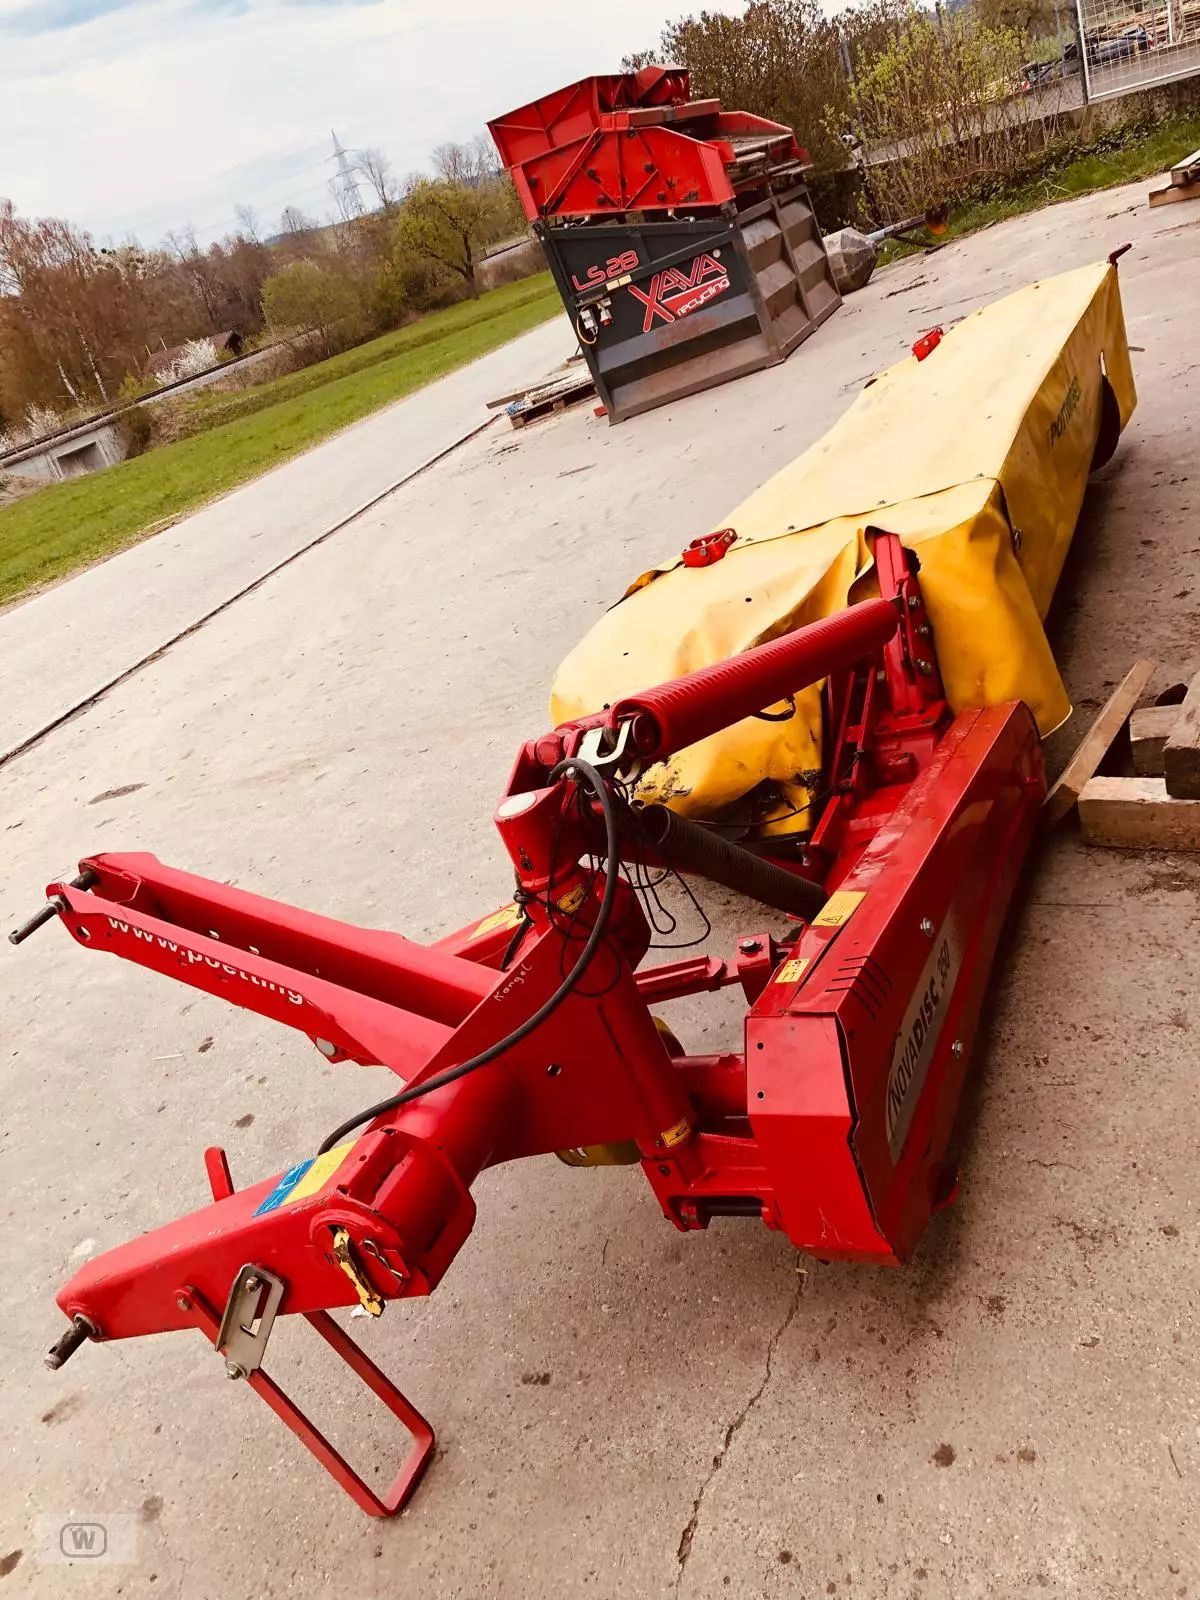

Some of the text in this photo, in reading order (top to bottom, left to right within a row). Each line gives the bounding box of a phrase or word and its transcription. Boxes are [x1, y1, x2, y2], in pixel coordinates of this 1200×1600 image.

[627, 253, 728, 333] XAVA
[676, 278, 731, 317] recycling
[889, 976, 940, 1116] NOVADISC
